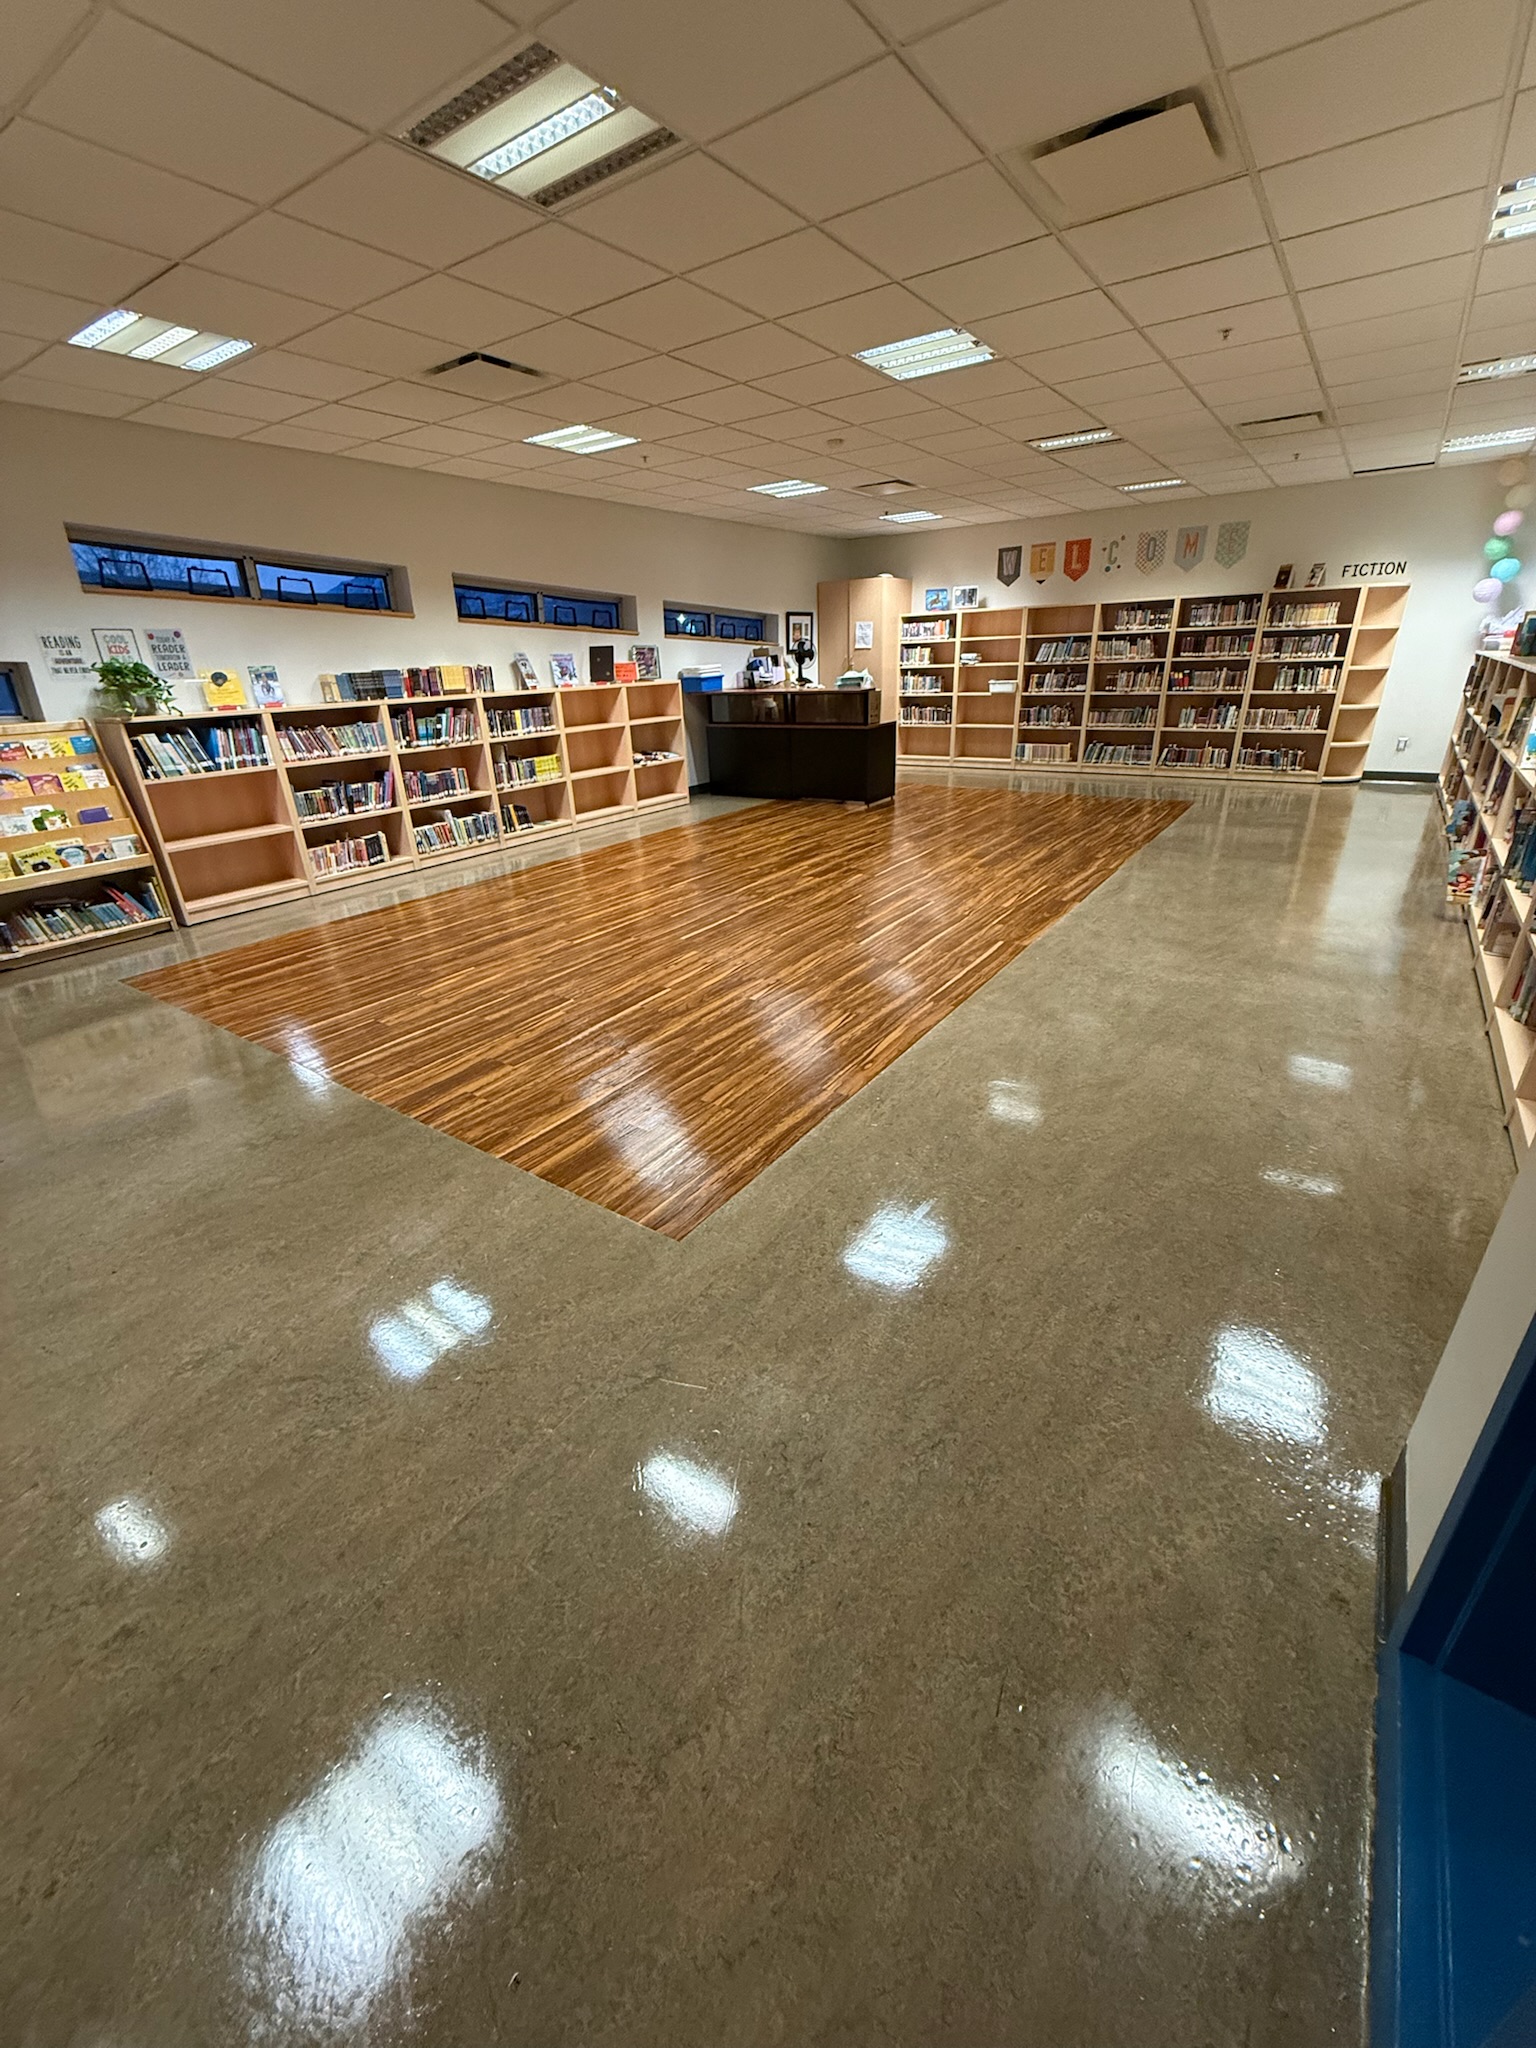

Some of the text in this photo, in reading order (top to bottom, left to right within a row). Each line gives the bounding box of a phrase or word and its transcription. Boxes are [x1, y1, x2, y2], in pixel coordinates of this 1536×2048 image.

[1001, 527, 1239, 576] WELCOME
[1341, 561, 1407, 578] FICTION
[40, 635, 82, 649] READING
[103, 634, 129, 645] COOL
[107, 644, 131, 655] KIDS
[151, 644, 186, 654] READER
[157, 661, 191, 672] LEADER
